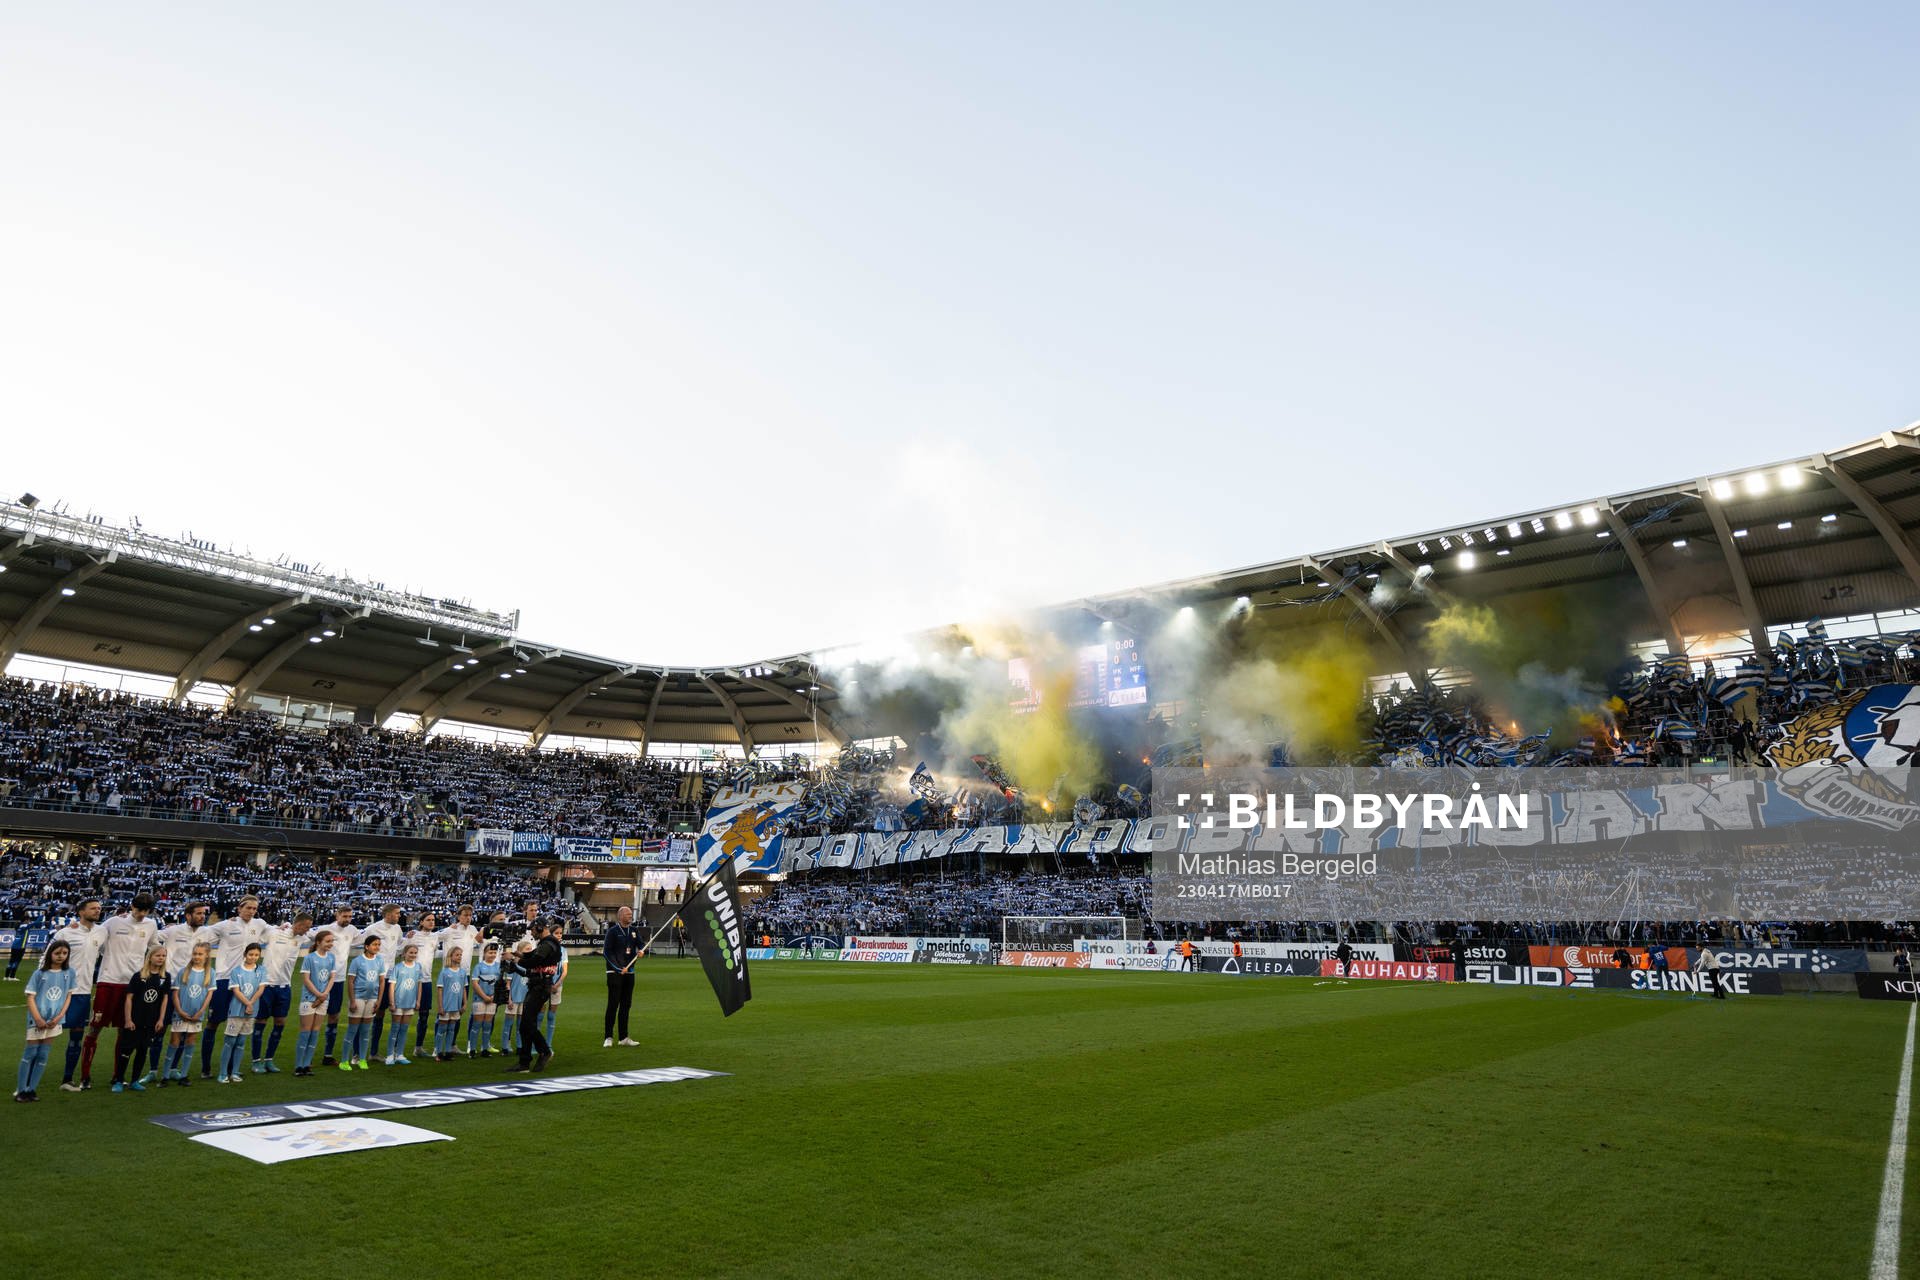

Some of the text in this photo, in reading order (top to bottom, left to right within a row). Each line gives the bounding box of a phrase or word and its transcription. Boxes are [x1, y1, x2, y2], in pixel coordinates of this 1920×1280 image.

[1821, 585, 1857, 601] J2
[93, 642, 123, 656] F4
[1115, 639, 1135, 650] 0:00
[311, 679, 336, 690] F3
[707, 881, 744, 981] UNIBET
[926, 938, 987, 952] merinfo.se
[1081, 941, 1114, 954] Brixo
[850, 950, 910, 962] INTERSPORT
[1021, 952, 1068, 967] Renova
[1716, 952, 1807, 969] CRAFT
[1245, 961, 1294, 974] ELEDA
[1335, 962, 1438, 980] BAUHAUS
[1465, 966, 1596, 989] GUIDE
[1631, 968, 1750, 995] SERNEKE
